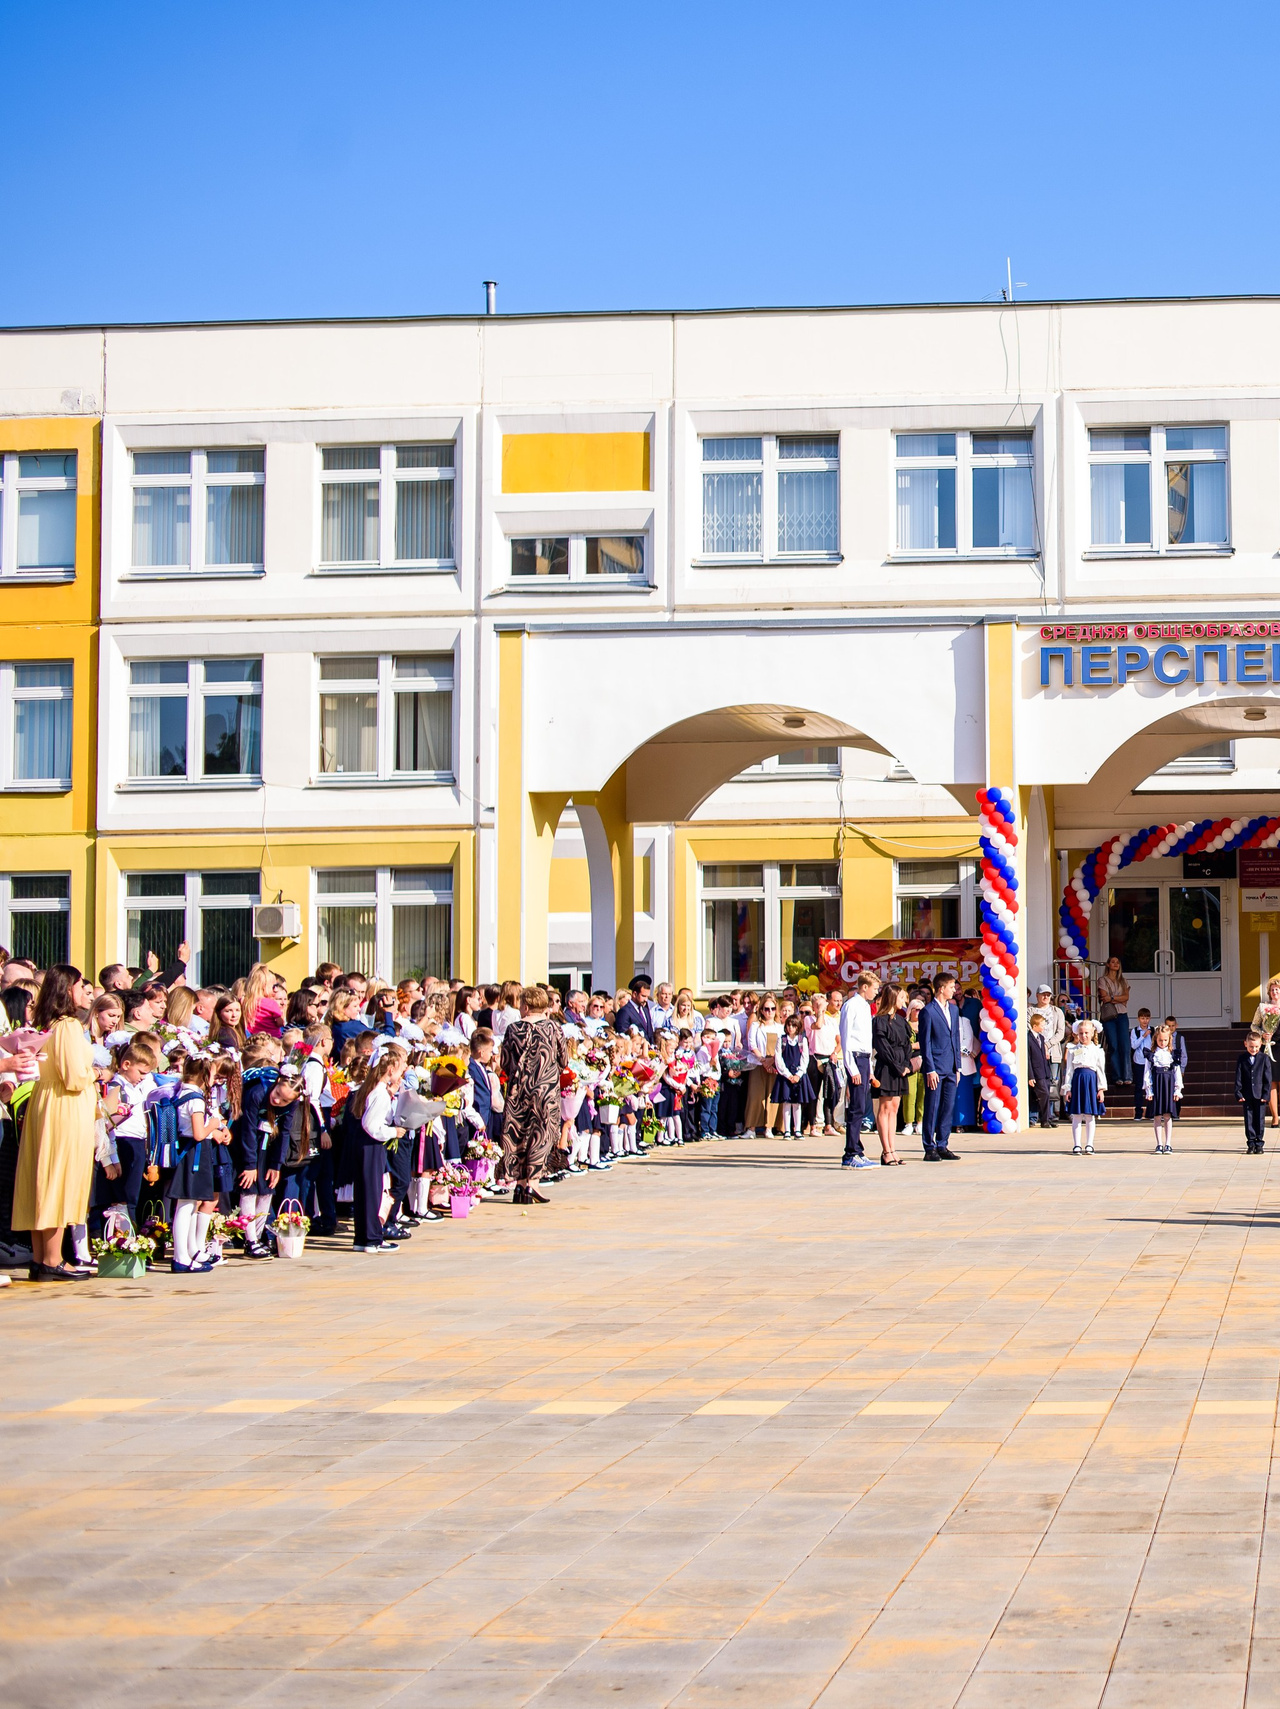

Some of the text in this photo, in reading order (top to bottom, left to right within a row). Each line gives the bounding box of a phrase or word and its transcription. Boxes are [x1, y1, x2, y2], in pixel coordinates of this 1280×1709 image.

[1040, 624, 1128, 642] СРЕДНЯЯ
[828, 948, 837, 965] 1
[841, 961, 985, 983] СЕНТЯБР
